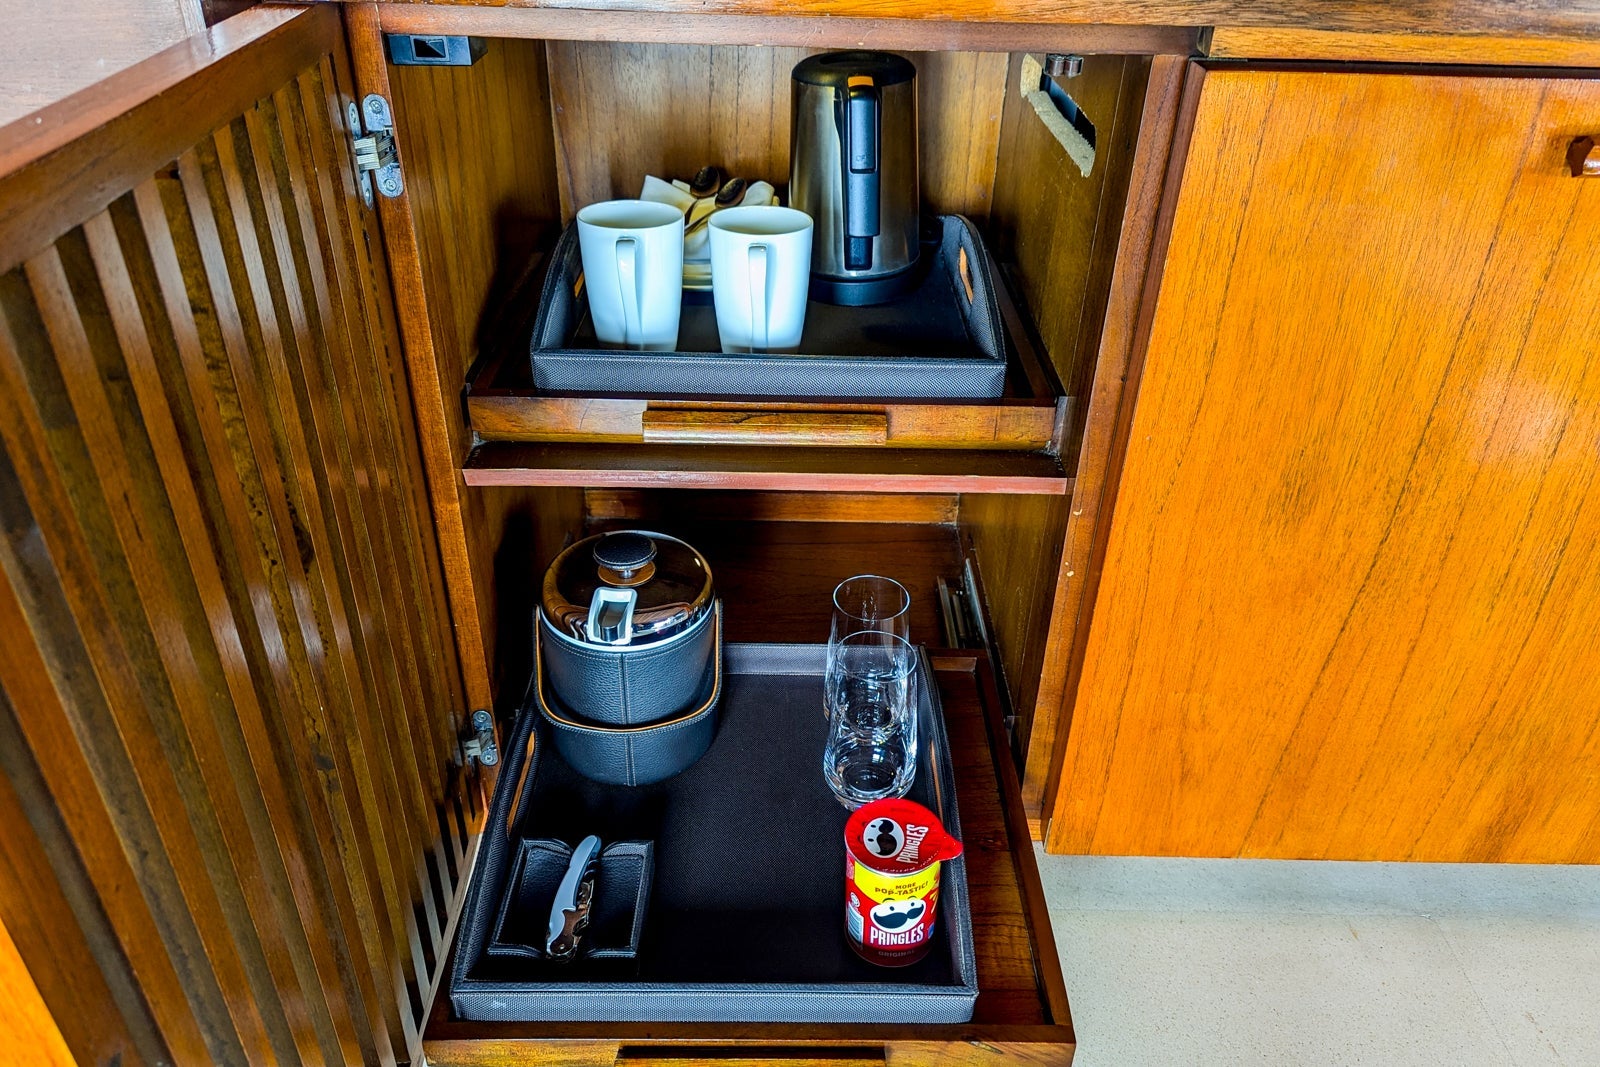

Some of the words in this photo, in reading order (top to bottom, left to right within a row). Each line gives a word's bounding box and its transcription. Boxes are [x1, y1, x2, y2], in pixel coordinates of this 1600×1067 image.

[896, 823, 929, 864] PRINGLES
[874, 881, 929, 896] POP-TASTIC!
[895, 882, 916, 890] MORE
[870, 923, 925, 946] PRINGLES
